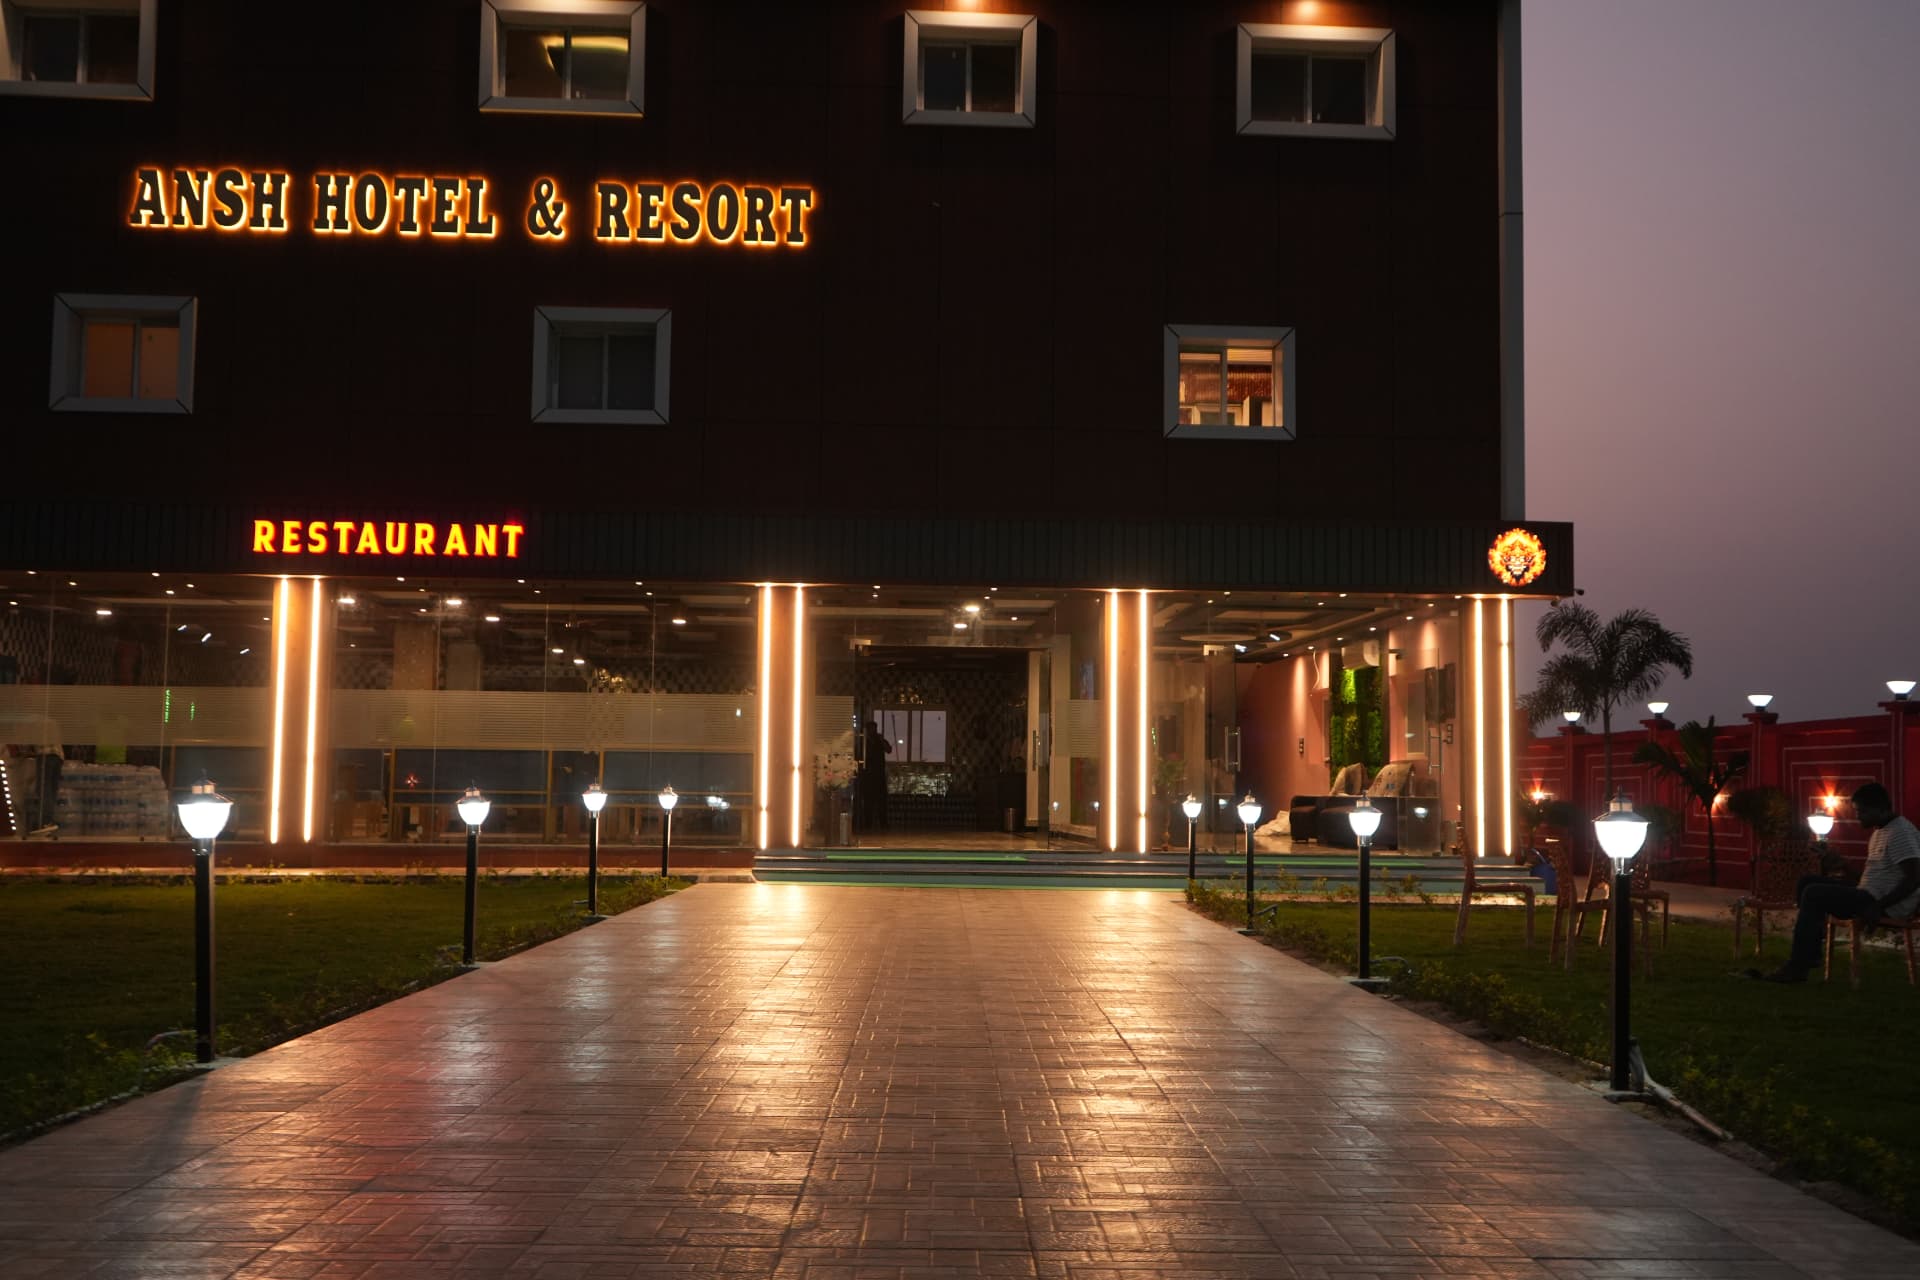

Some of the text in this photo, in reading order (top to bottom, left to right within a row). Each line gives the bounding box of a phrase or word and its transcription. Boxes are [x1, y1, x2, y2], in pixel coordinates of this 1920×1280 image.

[129, 167, 813, 248] ANSH HOTEL & RESORT
[252, 519, 524, 558] RESTAURANT
